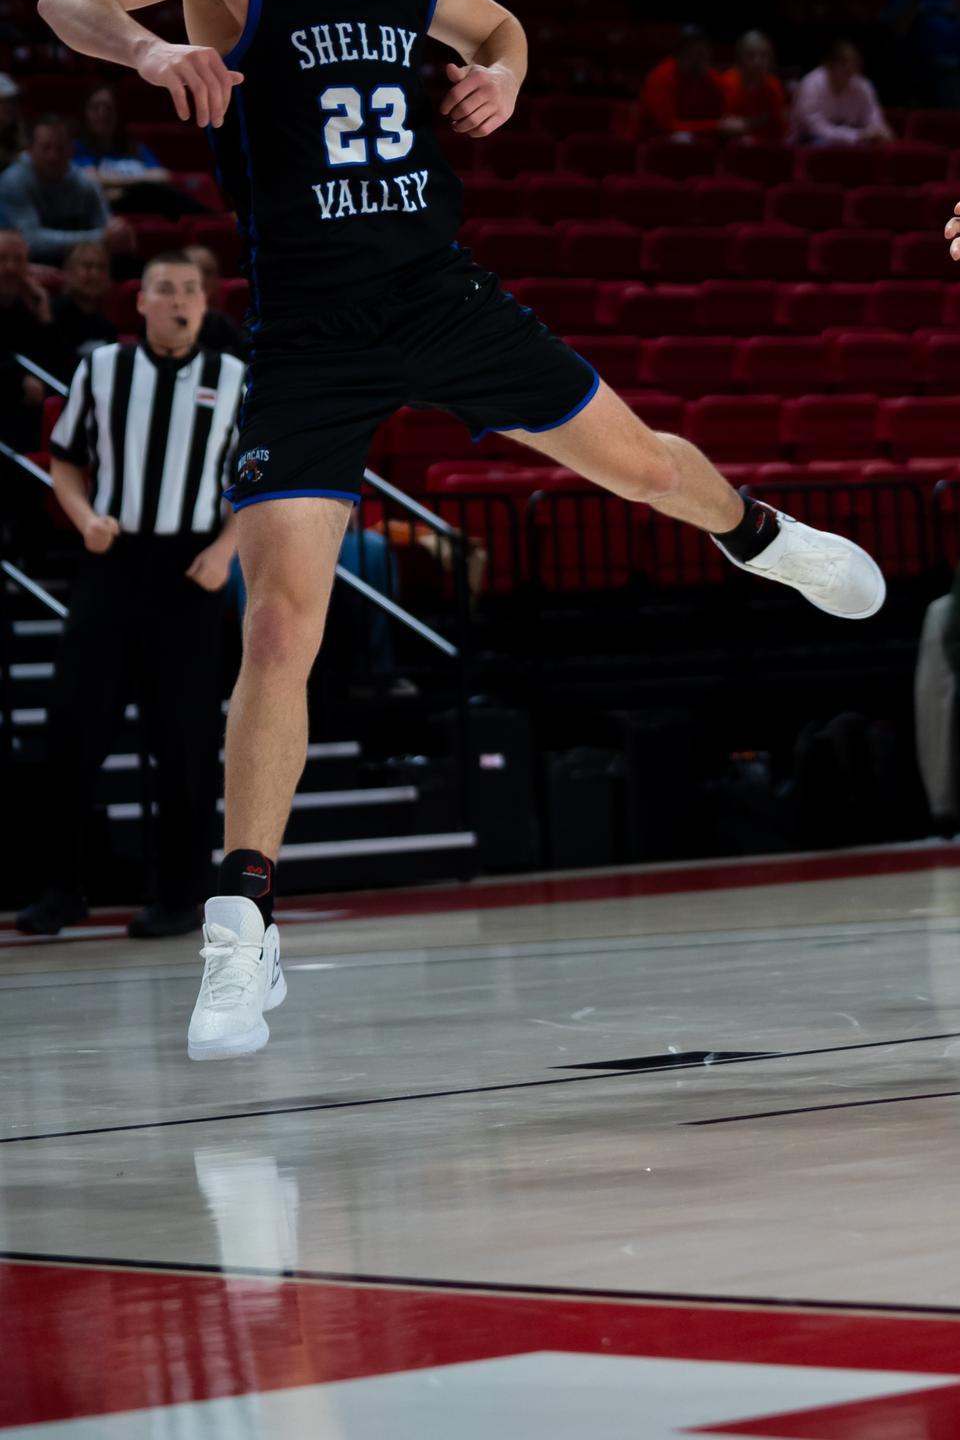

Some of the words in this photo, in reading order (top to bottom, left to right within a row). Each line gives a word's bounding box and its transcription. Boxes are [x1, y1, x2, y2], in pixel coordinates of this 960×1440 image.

[290, 22, 418, 70] SHELBY
[319, 85, 415, 166] 23
[311, 169, 429, 220] VALLEY
